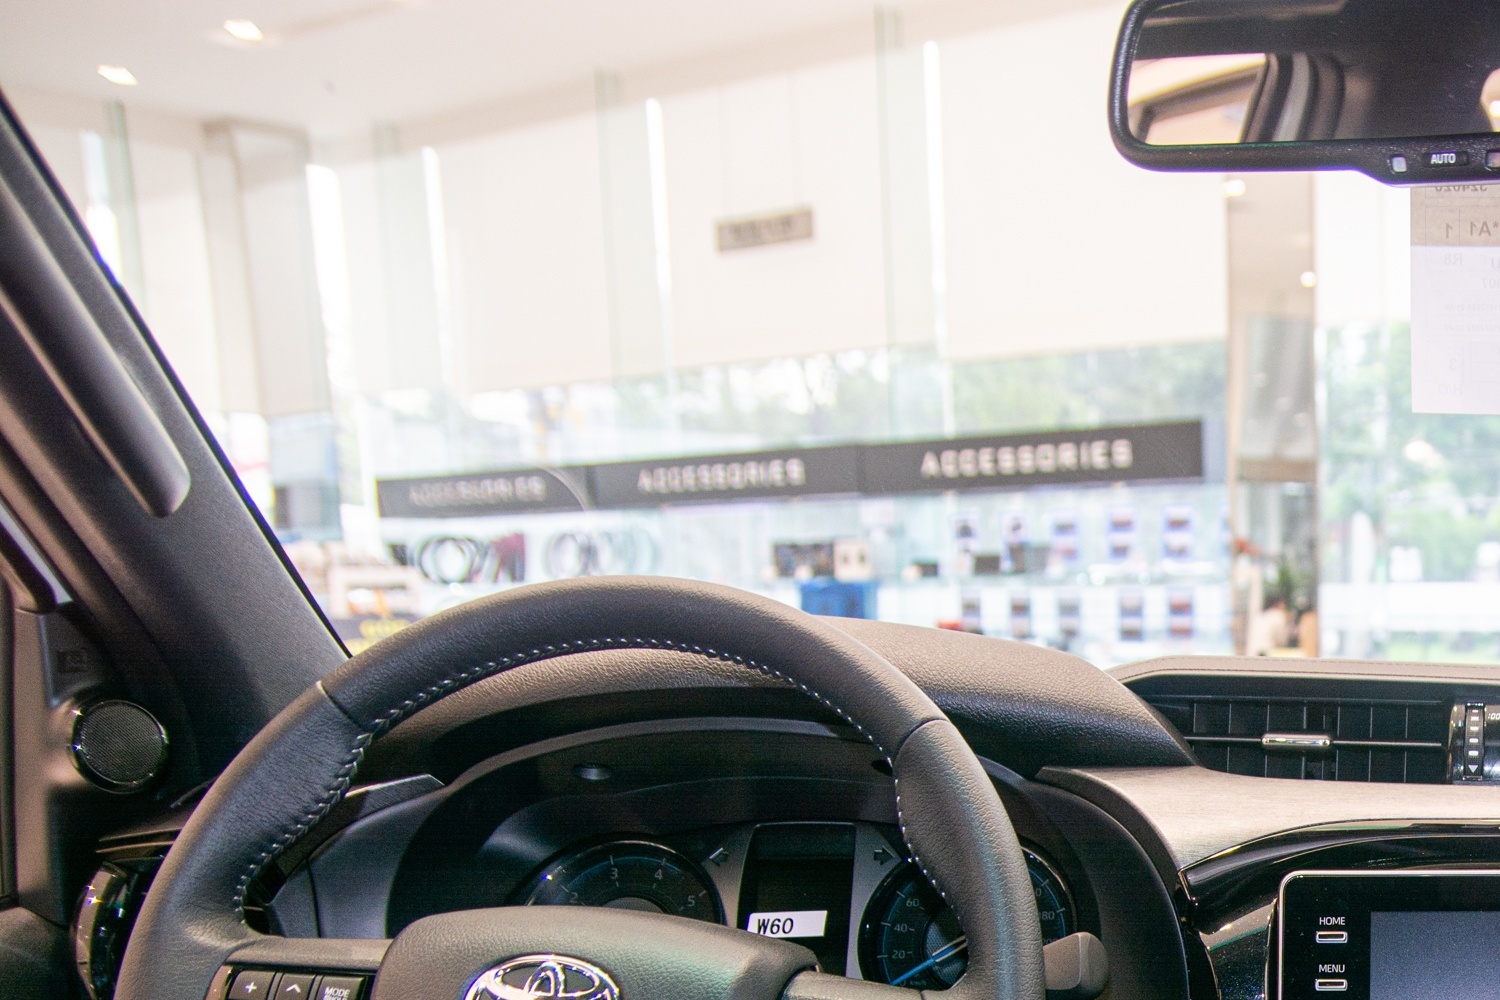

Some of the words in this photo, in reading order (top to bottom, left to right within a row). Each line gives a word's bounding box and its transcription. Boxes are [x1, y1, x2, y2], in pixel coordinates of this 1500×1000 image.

[1430, 153, 1456, 164] AUTO
[920, 439, 1134, 479] ACCESSORIES
[637, 457, 806, 494] ACCESSORIES
[610, 868, 619, 880] 3
[654, 868, 663, 880] 4
[687, 895, 696, 907] 5
[905, 898, 920, 907] 60
[757, 917, 794, 935] W60
[1319, 916, 1346, 925] HOME
[894, 923, 908, 933] 40
[891, 950, 905, 959] 20
[1318, 964, 1346, 973] MENU
[324, 986, 350, 997] MODE
